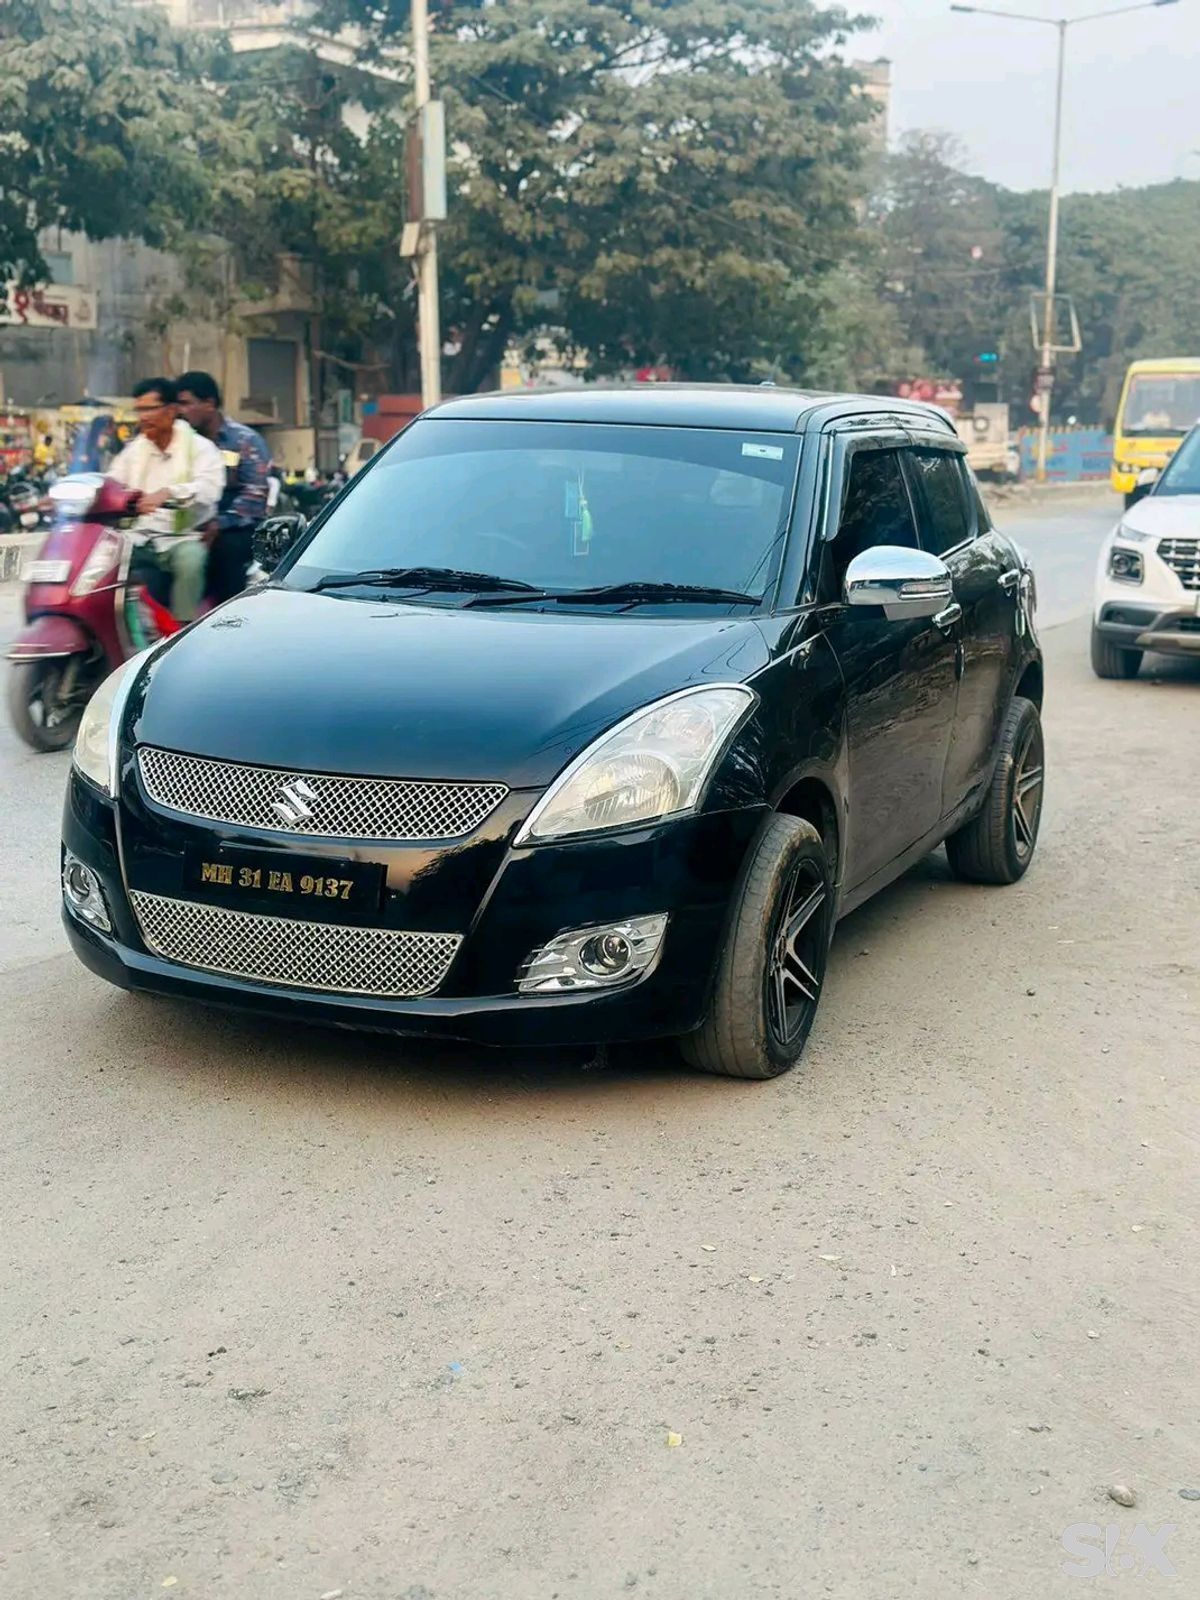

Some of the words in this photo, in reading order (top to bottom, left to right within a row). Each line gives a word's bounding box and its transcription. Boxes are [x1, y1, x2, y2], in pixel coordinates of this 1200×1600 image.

[201, 862, 233, 884] MH
[238, 867, 262, 888] 31
[267, 870, 293, 893] EA
[300, 875, 354, 900] 9137
